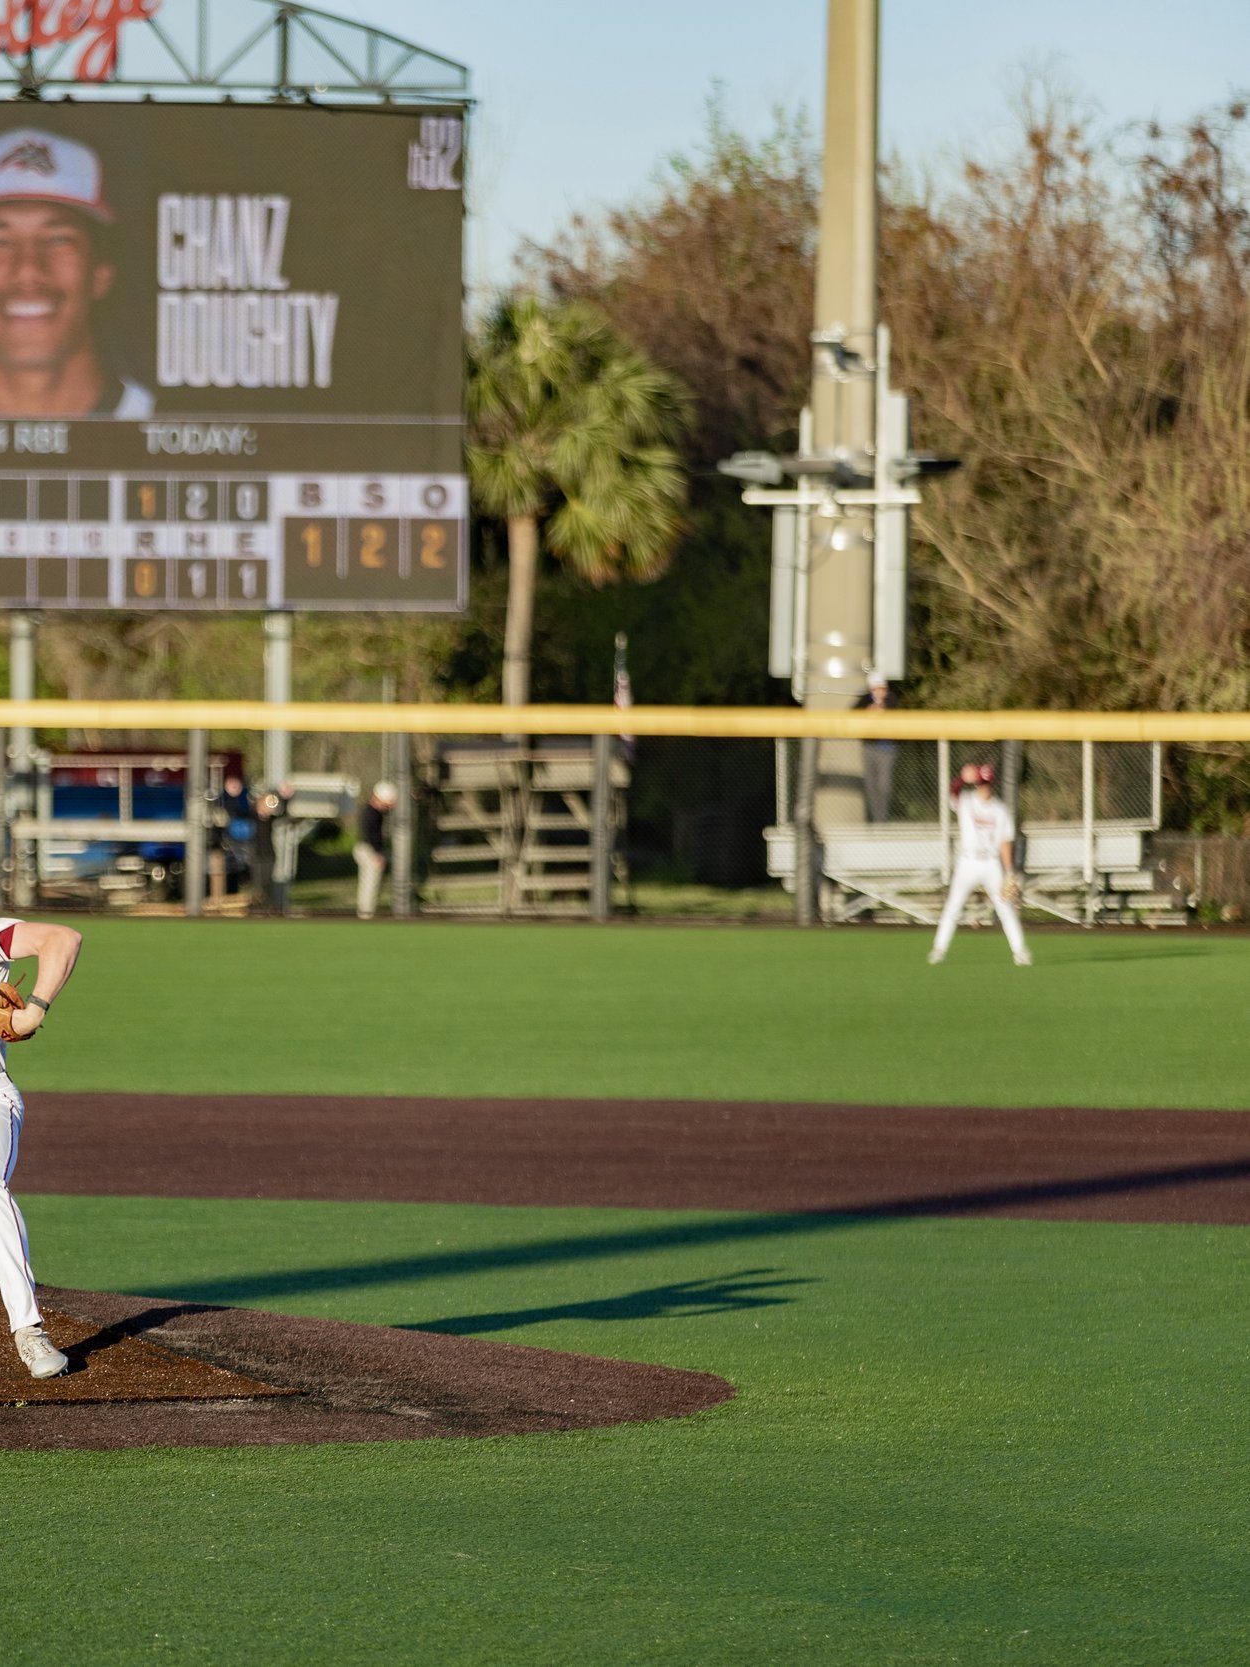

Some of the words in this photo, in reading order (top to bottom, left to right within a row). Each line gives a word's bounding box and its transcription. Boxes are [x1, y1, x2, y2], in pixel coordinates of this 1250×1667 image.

[157, 192, 291, 290] CHANZ
[156, 291, 340, 388] DOUGHTY
[14, 422, 69, 454] RBI
[138, 483, 156, 518] 1
[185, 482, 209, 519] 2
[235, 482, 259, 520] 0
[302, 482, 322, 508] B
[365, 482, 385, 508] S
[423, 482, 447, 509] O
[137, 530, 156, 556] R
[187, 531, 208, 556] H
[237, 531, 257, 556] E
[302, 522, 323, 568] 1
[360, 523, 387, 569] 2
[420, 523, 447, 569] 2
[134, 561, 157, 597] 0
[188, 561, 207, 599] 1
[238, 561, 257, 599] 1
